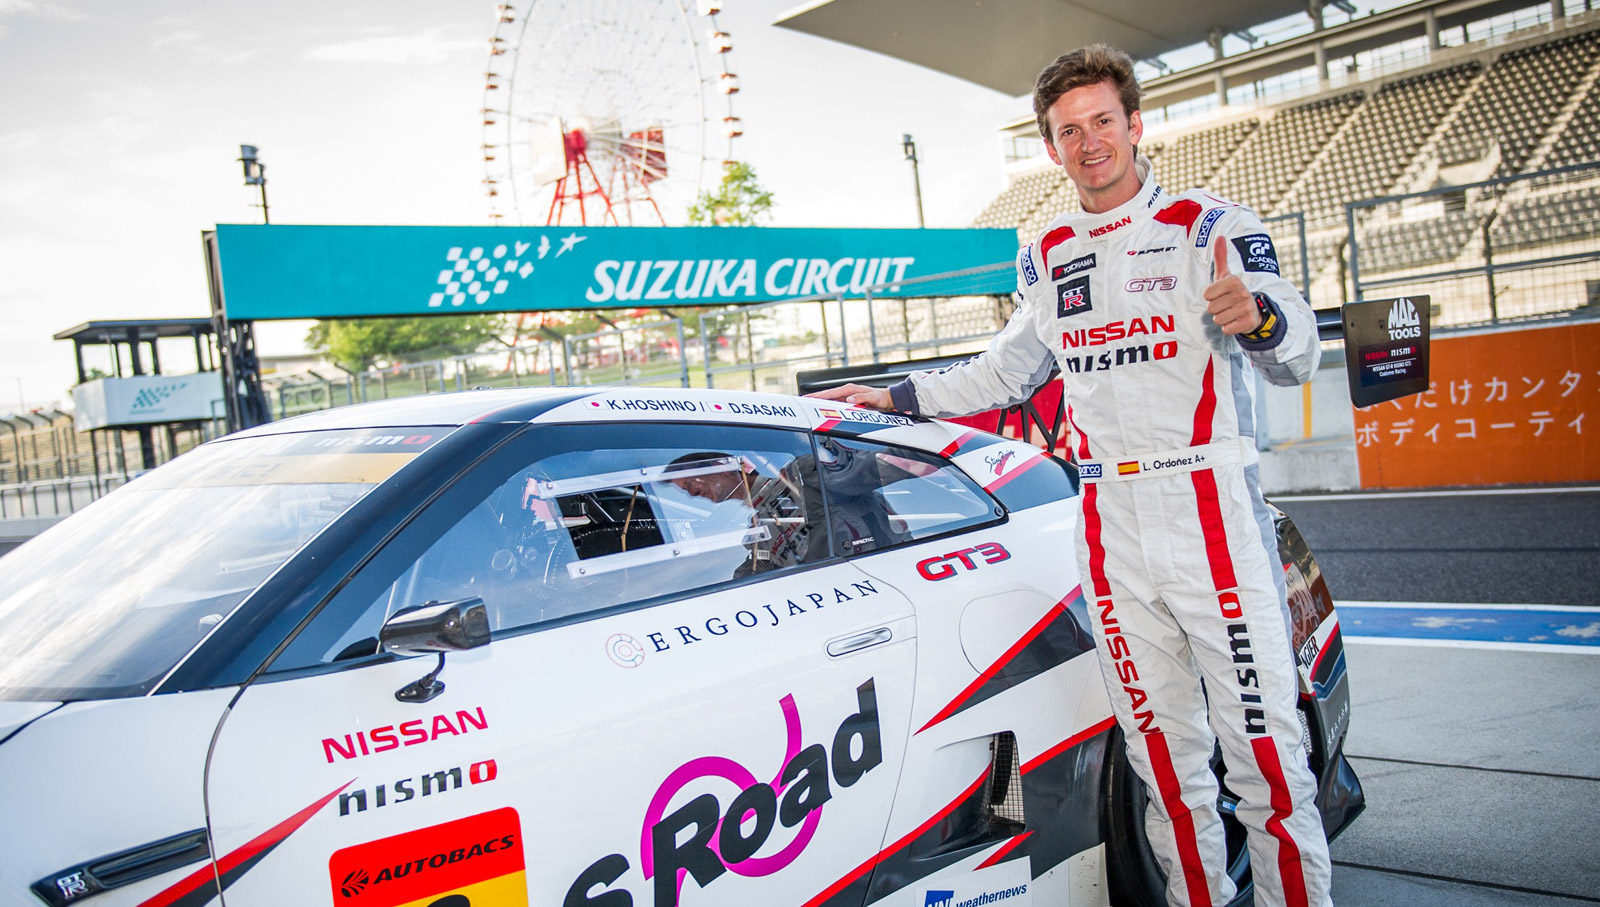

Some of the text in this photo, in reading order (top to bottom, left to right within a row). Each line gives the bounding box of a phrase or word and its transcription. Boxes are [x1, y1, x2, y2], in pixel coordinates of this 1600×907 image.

[1088, 216, 1132, 238] NISSAN
[586, 257, 915, 302] SUZUKA CIRCUIT
[1063, 258, 1094, 274] YOKOHAMA
[1125, 275, 1178, 293] GT3
[1388, 298, 1420, 329] MAC
[1062, 314, 1176, 350] NISSAN
[1388, 326, 1421, 341] TOOLS
[1066, 340, 1179, 374] nismo
[1365, 346, 1417, 360] NISSAN nismo
[609, 399, 696, 413] K.HOSHINO
[731, 402, 798, 418] D.SASAKI
[839, 410, 914, 427] L.ORDONEZ
[313, 434, 433, 448] nismo
[1142, 462, 1151, 471] L.
[1195, 454, 1206, 463] A+
[915, 541, 1012, 581] GT3
[1097, 599, 1161, 735] NISSAN
[1217, 591, 1267, 734] nismo
[321, 706, 489, 764] NISSAN
[339, 758, 498, 817] nismo
[373, 834, 515, 885] AUTOBACS
